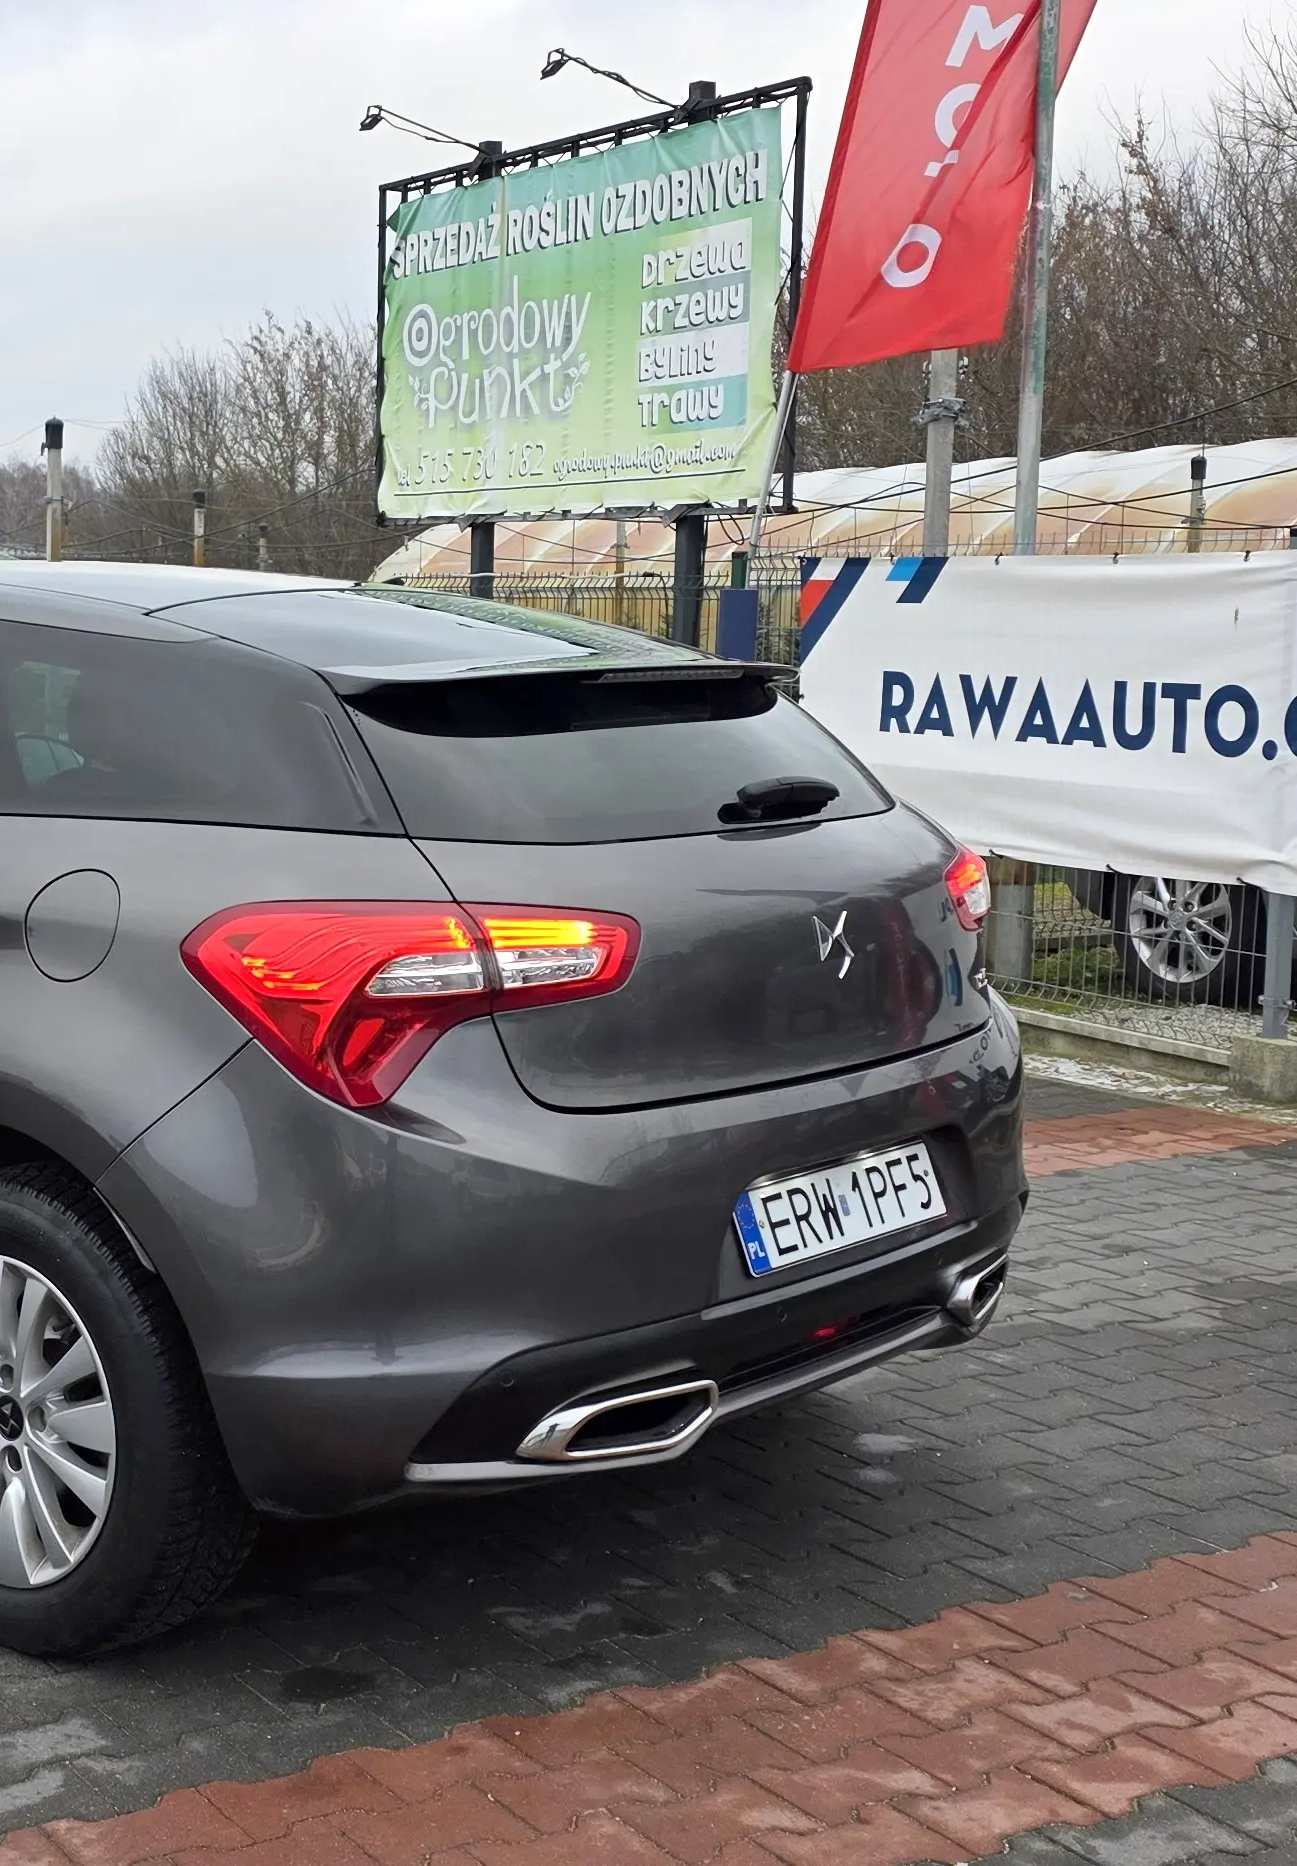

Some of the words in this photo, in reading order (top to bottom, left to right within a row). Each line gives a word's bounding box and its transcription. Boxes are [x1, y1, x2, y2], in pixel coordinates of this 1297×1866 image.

[392, 202, 501, 280] SPRZEDAŻ
[505, 191, 595, 257] ROŚLIN
[601, 148, 768, 236] OZDOBNYCH
[403, 274, 592, 369] Ogrodowy
[414, 449, 455, 486] 515
[462, 446, 497, 482] 730
[508, 440, 547, 478] 182
[879, 670, 1297, 761] RAWAAUTO.
[747, 1242, 766, 1261] PL
[760, 1177, 845, 1257] ERW
[851, 1153, 933, 1228] 1PF5
